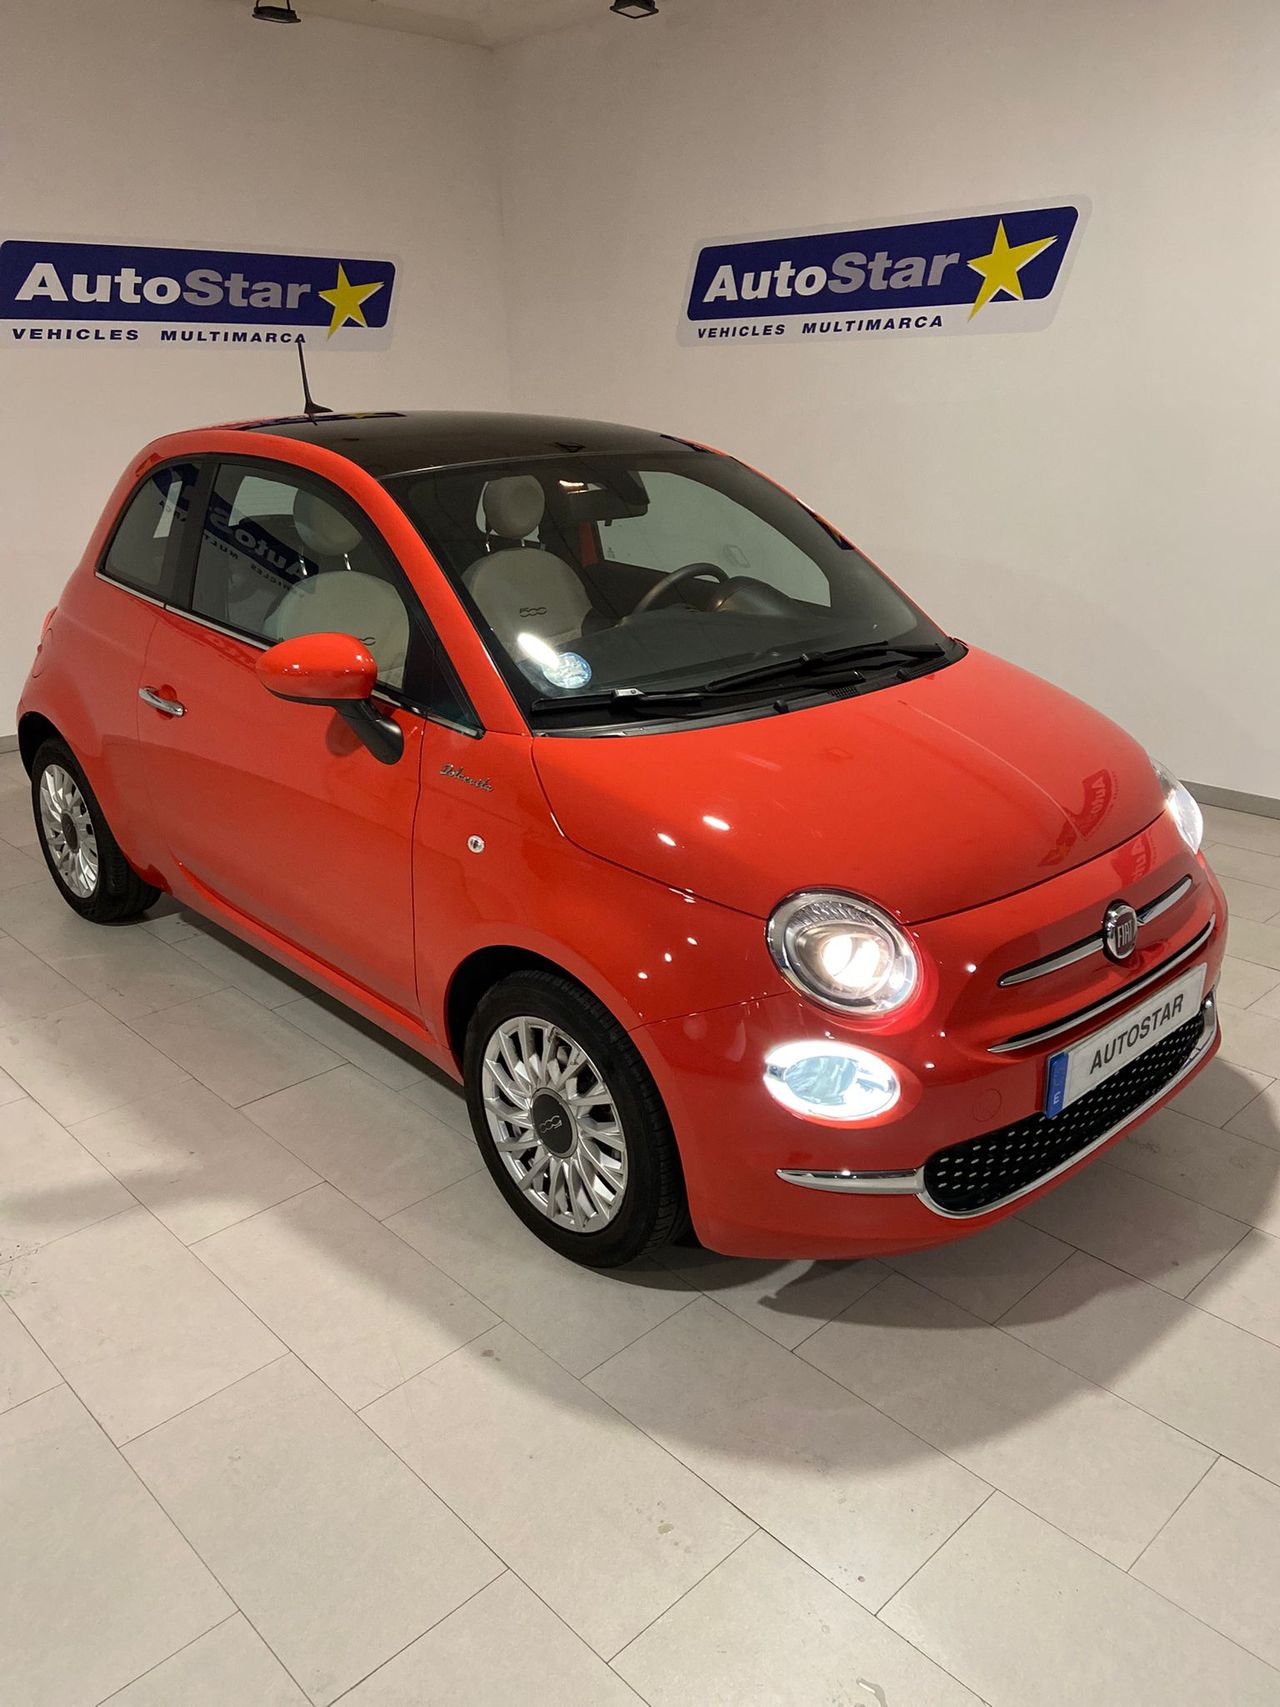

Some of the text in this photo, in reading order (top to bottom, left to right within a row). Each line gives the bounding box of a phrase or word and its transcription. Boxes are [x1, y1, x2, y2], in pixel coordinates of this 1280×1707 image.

[14, 262, 311, 308] AutoStar
[702, 252, 960, 303] AutoStar
[11, 328, 307, 343] VEHICLES MULTIMARCA
[697, 316, 943, 339] VEHICLES MULTIMARCA
[1117, 919, 1133, 948] FIAT
[1090, 993, 1184, 1075] AUTOSTAR
